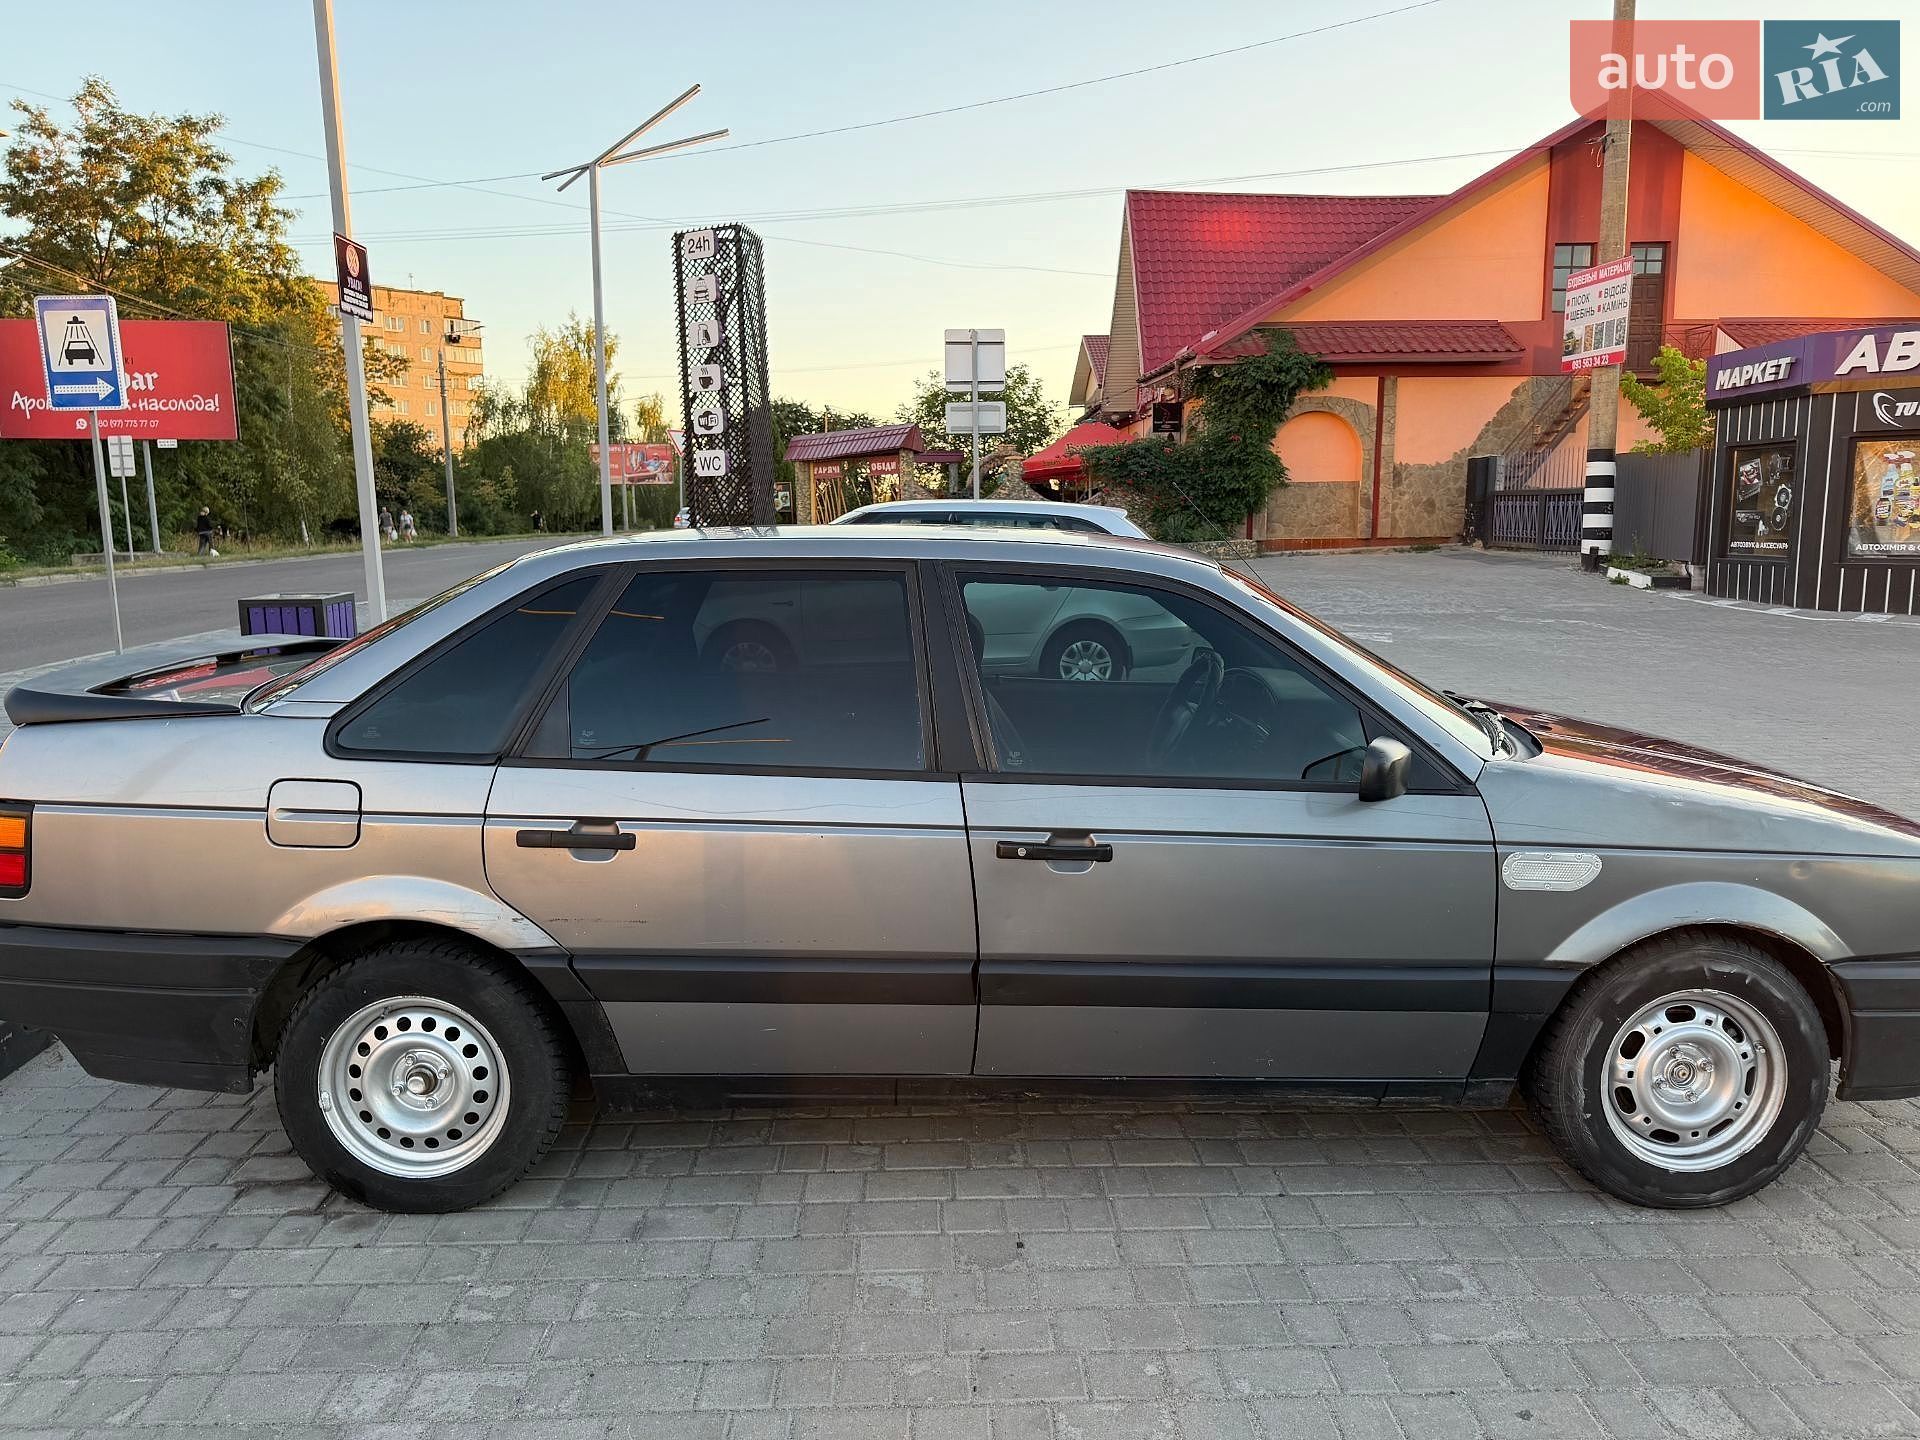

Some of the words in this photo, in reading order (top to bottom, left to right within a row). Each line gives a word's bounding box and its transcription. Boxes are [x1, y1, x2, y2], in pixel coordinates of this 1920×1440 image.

[688, 236, 710, 253] 24h
[1567, 271, 1598, 288] БУДІВЕЛЬНІ
[1599, 261, 1631, 279] МАТЕРІАЛИ
[1603, 283, 1627, 299] ВІДСІВ
[1571, 293, 1591, 307] ПІСОК
[1602, 299, 1628, 313] КАМІНЬ
[1570, 306, 1595, 321] ЩЕБІНЬ
[1601, 354, 1609, 365] 23
[1715, 356, 1794, 391] МАРКЕТ
[699, 456, 721, 471] WC
[871, 461, 897, 471] ОБІДИ
[1730, 541, 1755, 549] АВТОЗВУК
[1855, 543, 1906, 551] АВТОХІМІЯ
